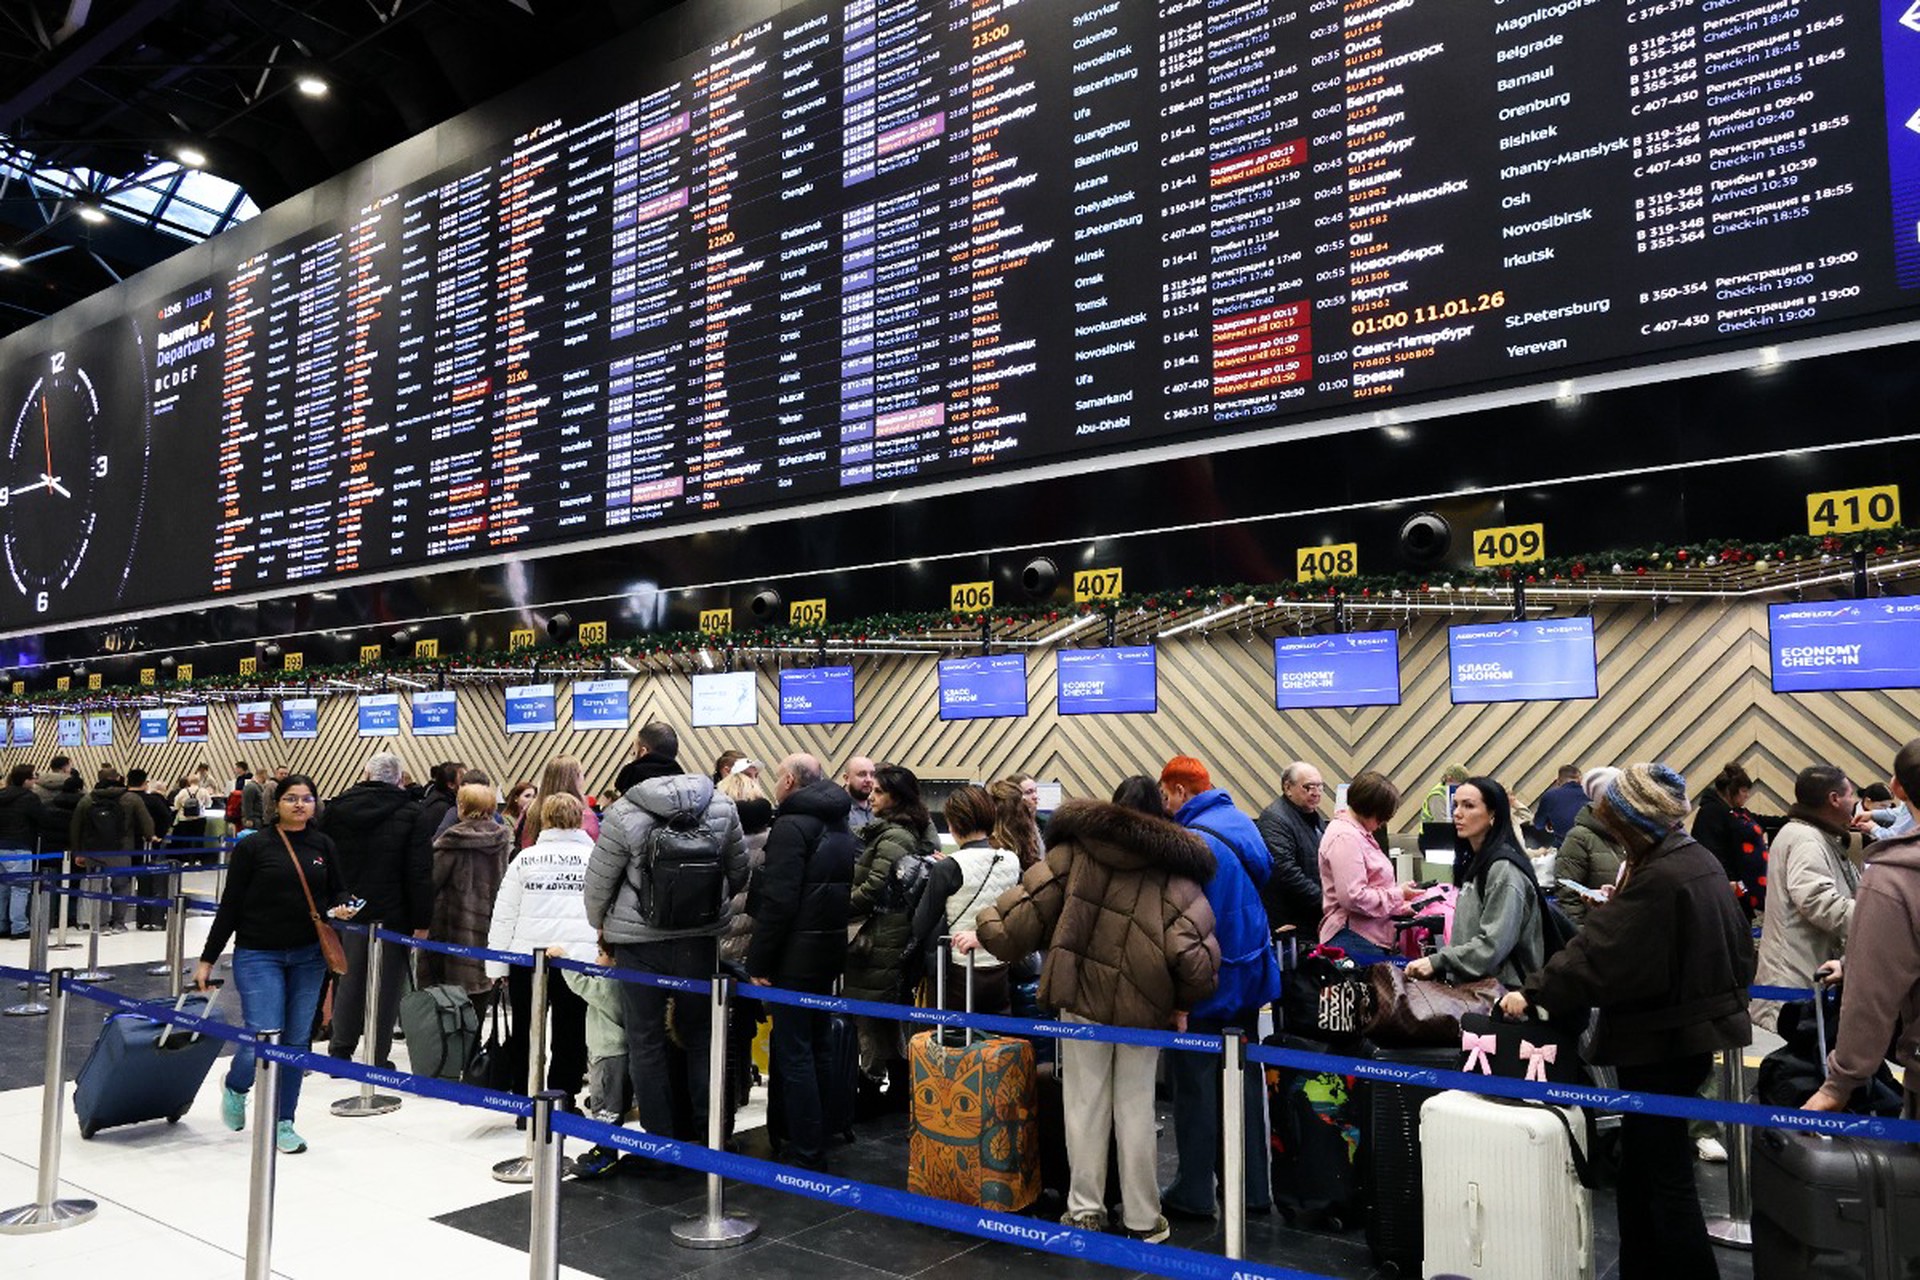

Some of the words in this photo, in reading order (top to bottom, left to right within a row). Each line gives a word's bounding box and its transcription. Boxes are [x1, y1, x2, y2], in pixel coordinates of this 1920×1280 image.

[1627, 13, 1636, 23] C
[1704, 22, 1758, 42] Check-in
[1763, 8, 1799, 26] 18:40
[973, 24, 1009, 48] 23:00
[1073, 27, 1117, 49] Colombo
[1344, 35, 1382, 54] Омск
[1705, 32, 1789, 62] Регистрация
[1806, 15, 1844, 34] 18:45
[1073, 44, 1132, 74] Novosibirsk
[1497, 34, 1563, 62] Belgrade
[1628, 44, 1638, 54] B
[1705, 54, 1759, 74] Check-in
[1765, 41, 1800, 58] 18:45
[1346, 43, 1444, 82] Магнитогорск
[1074, 68, 1138, 96] Ekaterinburg
[1498, 65, 1554, 91] Barnaul
[1346, 84, 1404, 109] Белград
[1499, 92, 1570, 120] Orenburg
[1632, 105, 1640, 116] C
[1643, 90, 1698, 111] 407-430
[1708, 107, 1760, 126] Прибыл
[1775, 91, 1814, 108] 09:40
[1347, 112, 1404, 136] Барнаул
[1708, 120, 1754, 139] Arrived
[1757, 110, 1794, 126] 09:40
[1500, 125, 1557, 150] Bishkek
[1075, 141, 1138, 168] Ekaterinburg
[1347, 136, 1415, 163] Оренбург
[1501, 137, 1629, 180] Khanty-Mansiysk
[1348, 168, 1402, 190] Бишкек
[1711, 172, 1764, 190] Прибыл
[1780, 158, 1817, 175] 10:39
[1314, 185, 1343, 200] 00:45
[1502, 192, 1530, 208] Osh
[1712, 185, 1757, 202] Arrived
[1762, 176, 1797, 191] 10:39
[1075, 190, 1135, 216] Chelyabinsk
[1503, 208, 1592, 238] Novosibirsk
[1315, 240, 1344, 254] 00:55
[1350, 232, 1372, 245] Ош
[1075, 248, 1104, 264] Minsk
[1350, 244, 1444, 274] Новосибирск
[1504, 248, 1554, 268] Irkutsk
[1716, 264, 1802, 288] Регистрация
[1819, 251, 1858, 268] 19:00
[1075, 274, 1103, 288] Omsk
[1352, 281, 1408, 302] Иркутск
[1716, 283, 1772, 299] Check-in
[1777, 274, 1813, 288] 19:00
[1640, 293, 1649, 304] B
[1653, 281, 1708, 301] 350-354
[1717, 298, 1804, 320] Регистрация
[1821, 286, 1860, 301] 19:00
[1075, 296, 1108, 312] Tomsk
[1352, 312, 1408, 335] 01:00
[1415, 291, 1504, 323] 11.01.26
[1506, 299, 1610, 328] St.Petersburg
[1075, 312, 1146, 336] Novokuznetsk
[1641, 324, 1650, 334] C
[1653, 314, 1709, 332] 407-430
[1718, 316, 1773, 332] Check-in
[1779, 308, 1815, 322] 19:00
[157, 333, 215, 368] Departures
[1076, 340, 1135, 360] Novosibirsk
[1352, 325, 1474, 357] Санкт-Петербург
[1506, 338, 1567, 358] Yerevan
[51, 352, 65, 374] 12
[1318, 350, 1348, 364] 01:00
[163, 375, 170, 389] C
[172, 372, 180, 386] D
[181, 368, 188, 383] E
[191, 365, 197, 380] F
[1076, 374, 1093, 386] Ufa
[1318, 379, 1348, 391] 01:00
[1353, 368, 1404, 387] Ереван
[1076, 390, 1132, 410] Samarkand
[1075, 416, 1131, 435] Abu-Dhabi
[96, 456, 108, 477] 3
[1813, 493, 1895, 527] 410
[1478, 531, 1540, 559] 409
[1300, 551, 1355, 576] 408
[1077, 574, 1119, 597] 407
[37, 592, 48, 612] 6
[953, 588, 991, 608] 406
[701, 612, 730, 630] 404
[792, 604, 823, 622] 405
[581, 625, 604, 643] 403
[1781, 644, 1861, 657] ECONOMY
[1781, 654, 1859, 667] CHECK-IN
[1282, 671, 1335, 682] ECONOMY
[1458, 662, 1501, 673] КЛАСС
[1458, 670, 1513, 682] ЭКОНОМ
[1282, 679, 1334, 689] CHECK-IN
[1174, 1037, 1220, 1049] AEROFLOT
[1354, 1065, 1409, 1079] AEROFLOT
[1546, 1089, 1609, 1104] AEROFLOT
[1770, 1114, 1845, 1130] AEROFLOT
[610, 1133, 657, 1153] AEROFLOT
[774, 1172, 833, 1195] AEROFLOT
[976, 1217, 1047, 1243] AEROFLOT
